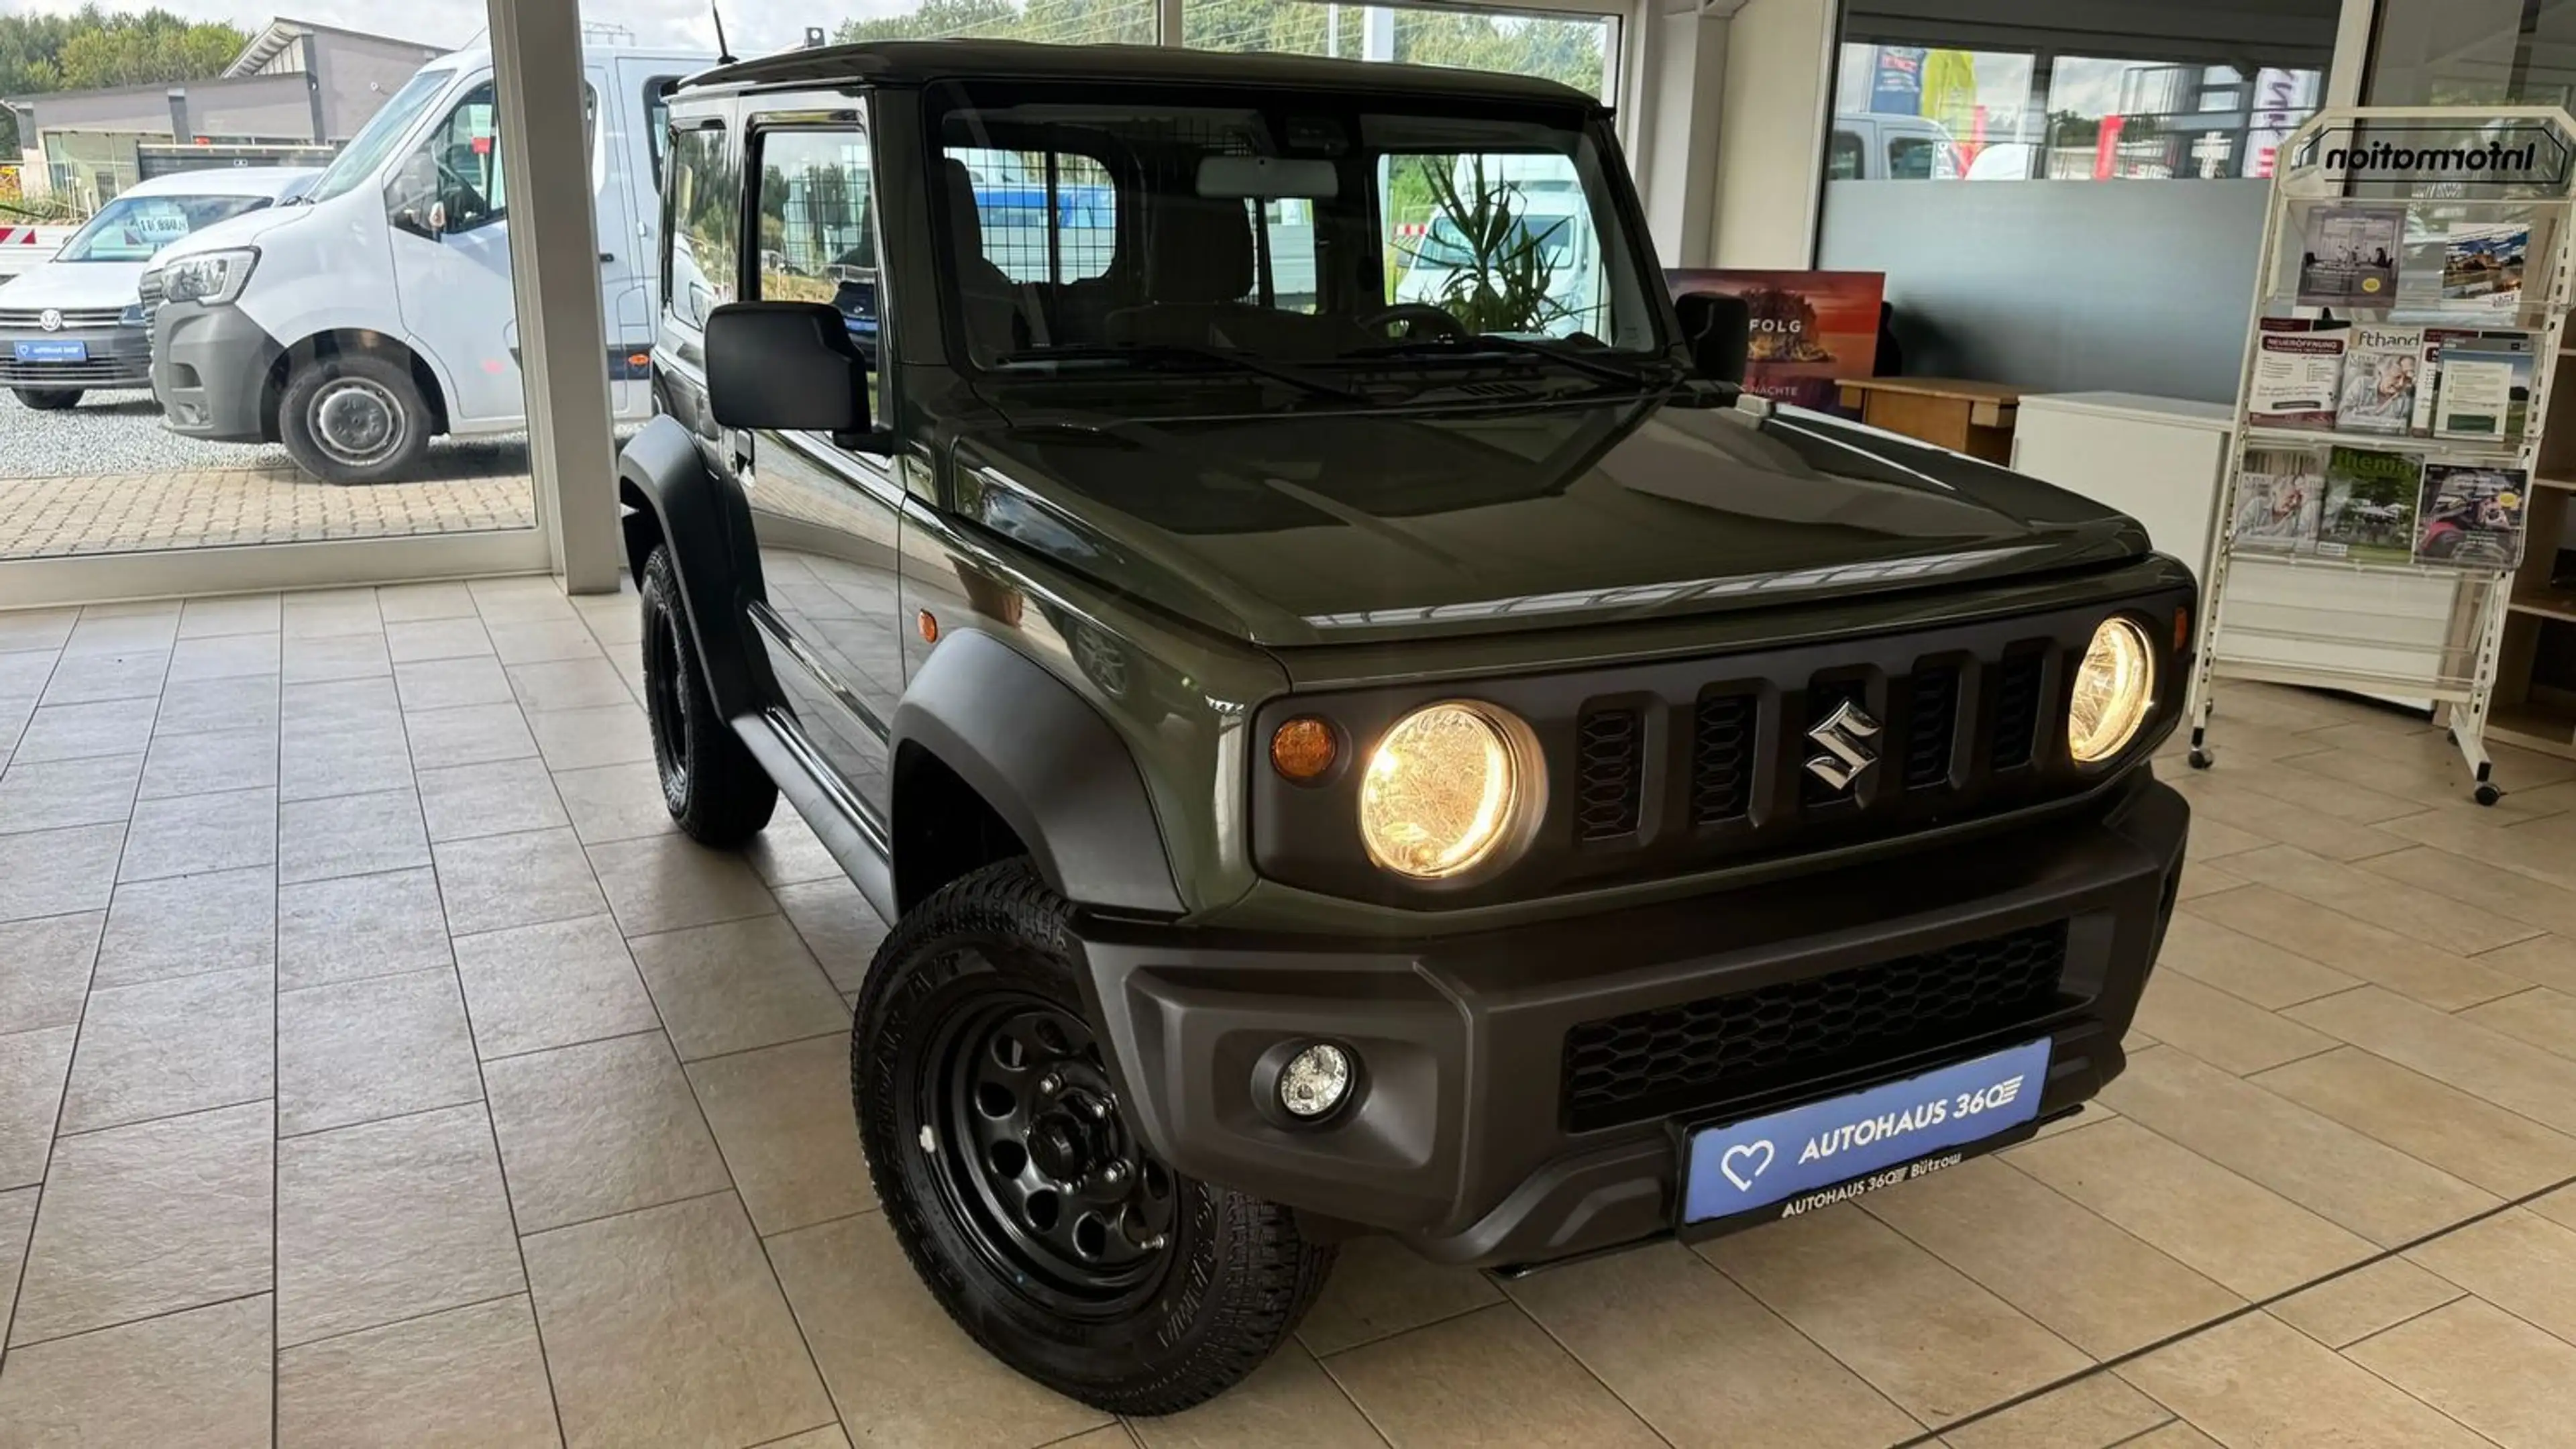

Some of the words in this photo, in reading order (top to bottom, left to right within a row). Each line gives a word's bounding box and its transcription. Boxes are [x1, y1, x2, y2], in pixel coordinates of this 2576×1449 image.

[1798, 1098, 1948, 1165] AUTOHAUS
[1952, 1075, 2025, 1119] 360
[1782, 1181, 1864, 1218] AUTOHAUS
[1911, 1152, 1962, 1177] Bützow
